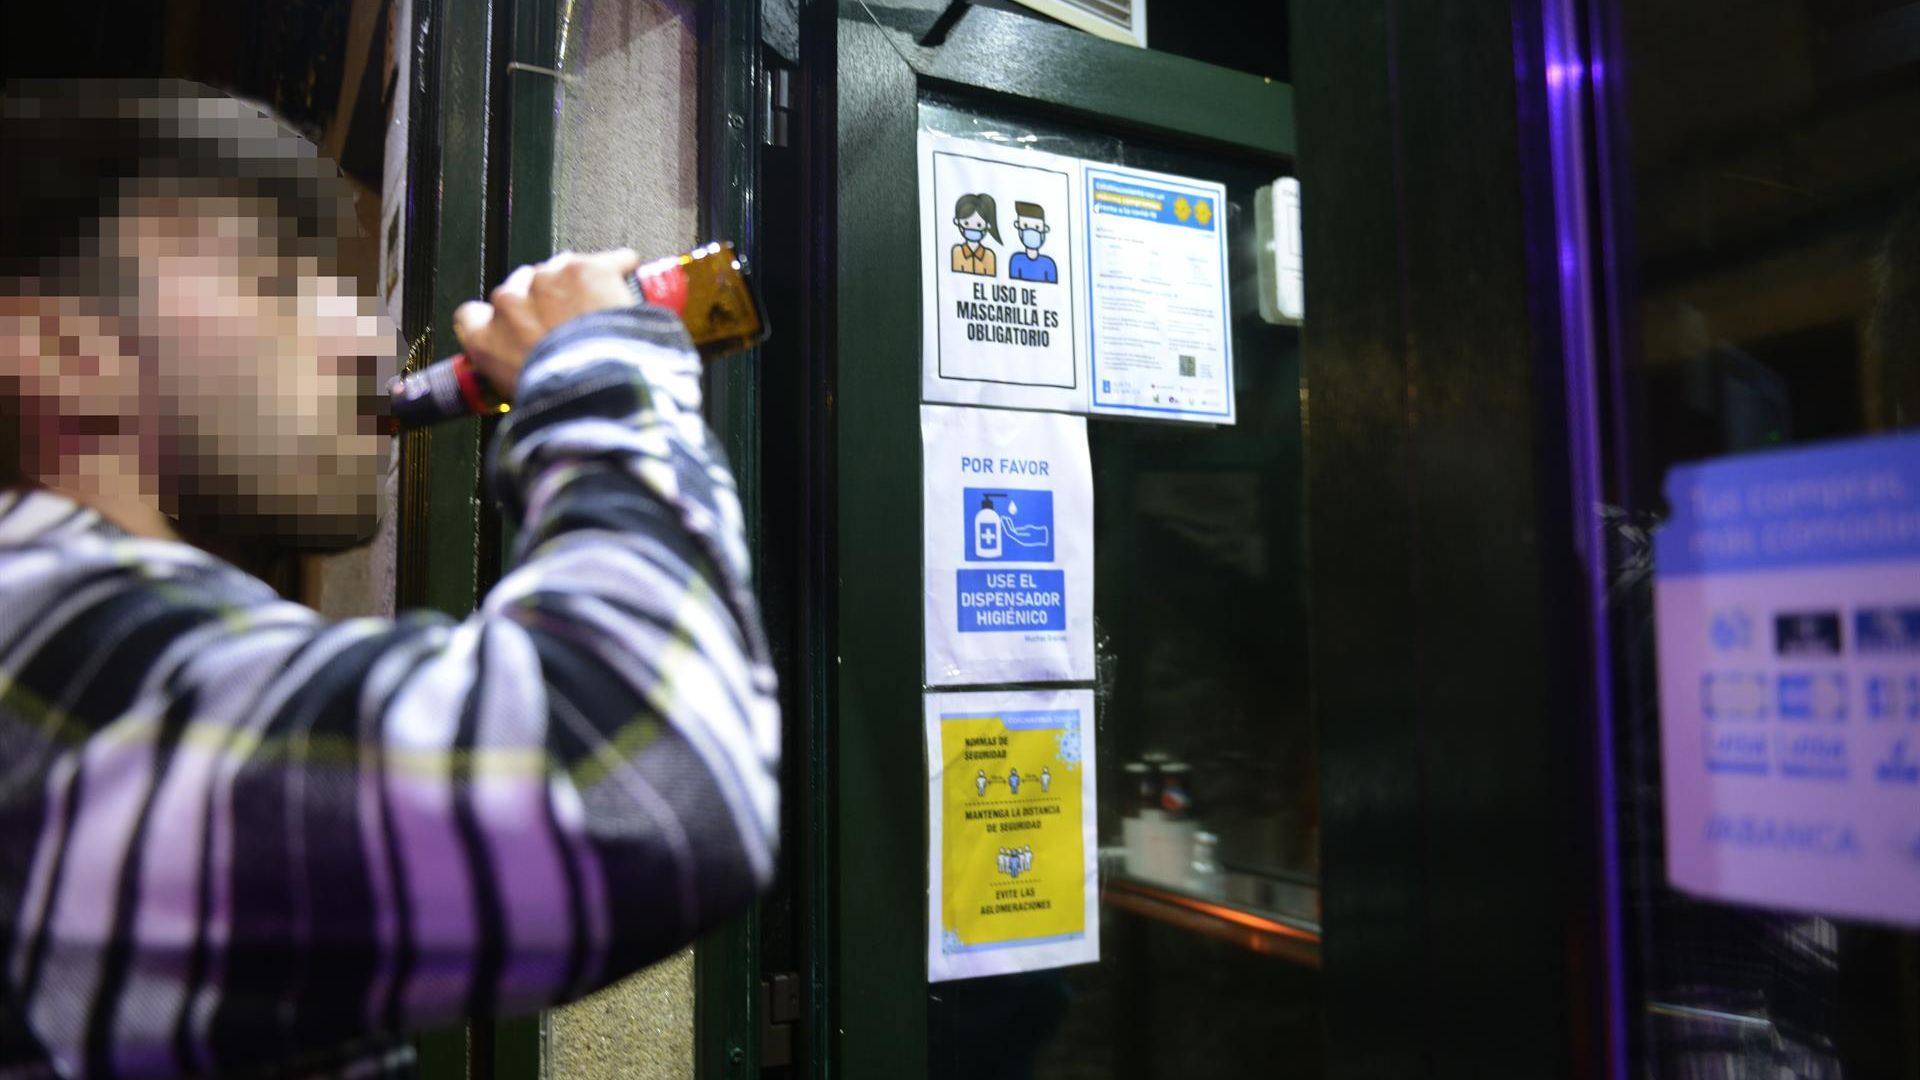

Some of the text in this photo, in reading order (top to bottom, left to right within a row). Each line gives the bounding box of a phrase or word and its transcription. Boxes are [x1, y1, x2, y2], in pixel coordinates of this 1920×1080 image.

[973, 282, 1037, 307] EL USO DE
[956, 300, 1059, 329] MASCARILLA ES
[967, 322, 1050, 348] OBLIGATORIO
[961, 456, 1050, 477] POR FAVOR
[986, 573, 1037, 589] USE EL
[961, 591, 1060, 608] DISPENSADOR
[976, 606, 1048, 626] HIGIÉNICO
[964, 735, 1008, 747] NORMAS DE
[964, 748, 1007, 761] SEGURIDAD
[964, 805, 1061, 820] MANTENGA LA DISTANCIA
[986, 820, 1042, 833] DE SEGURIDAD
[996, 886, 1035, 901] EVITE LAS
[980, 900, 1051, 916] AGLOMERACIONES
